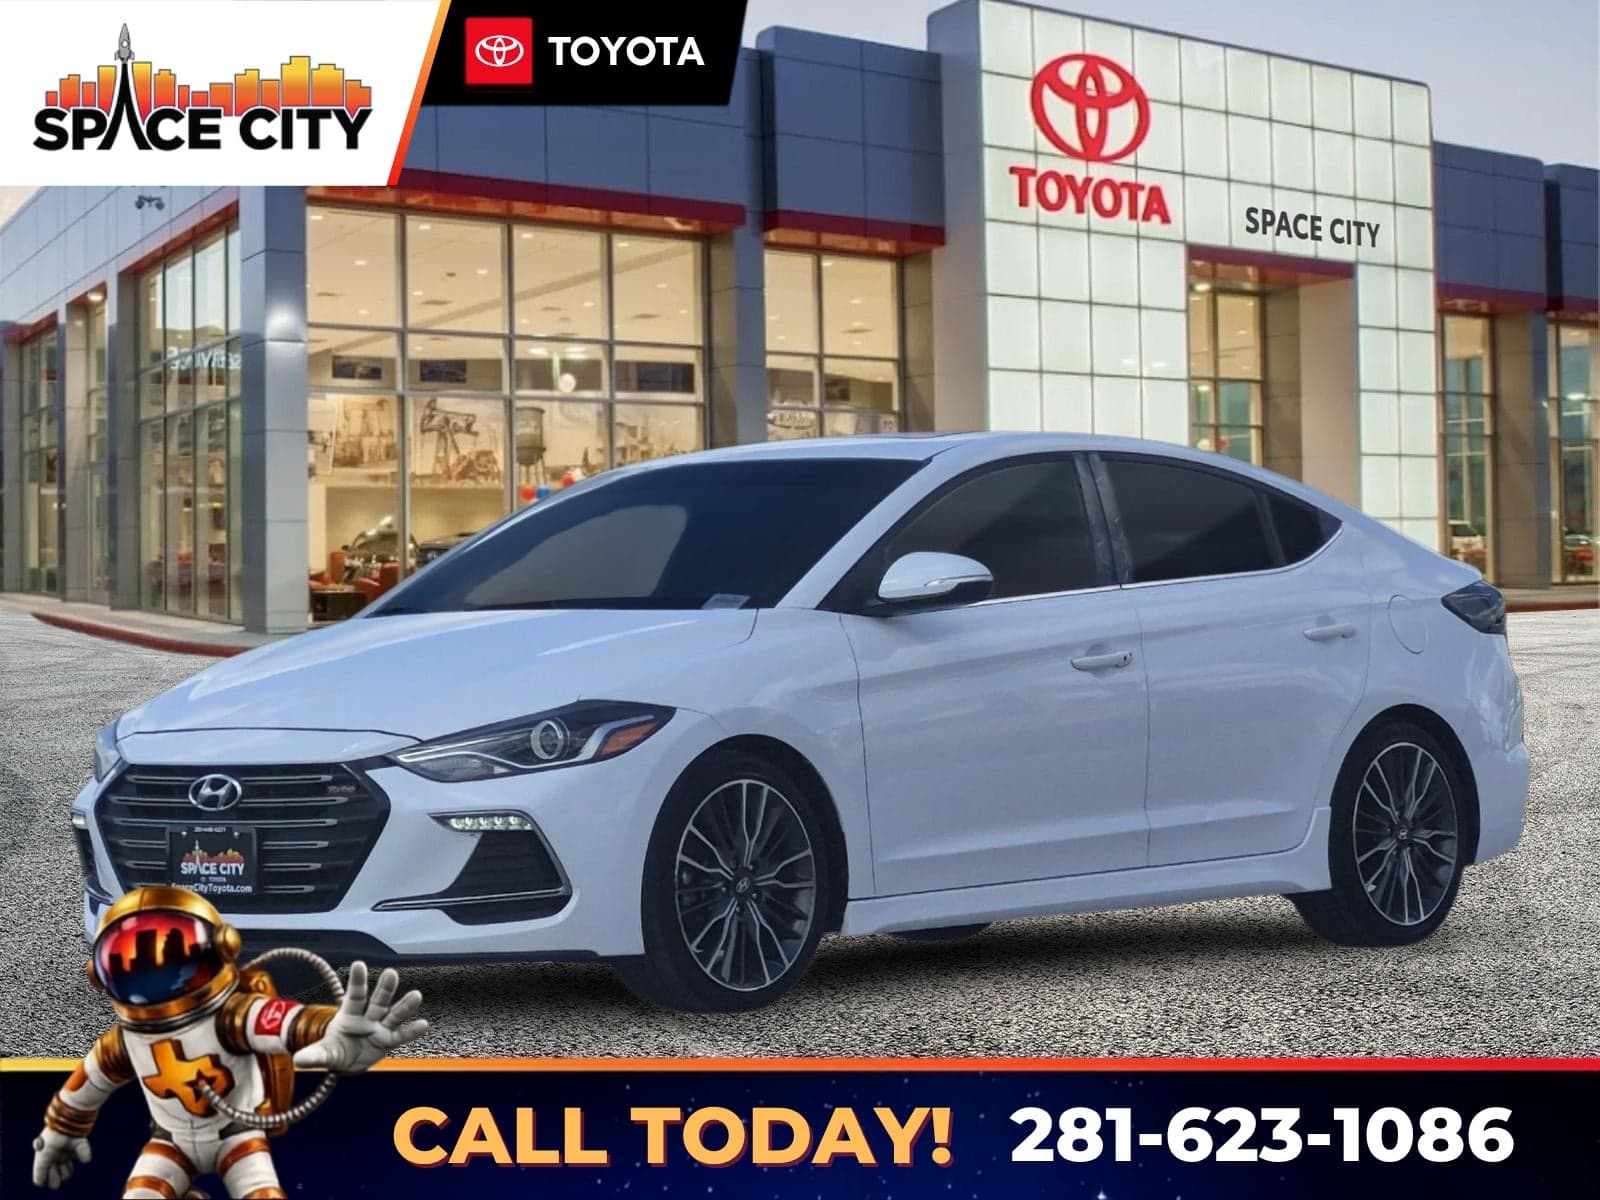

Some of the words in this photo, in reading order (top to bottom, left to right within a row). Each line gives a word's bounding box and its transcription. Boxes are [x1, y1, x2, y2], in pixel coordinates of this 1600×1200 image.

[1009, 166, 1171, 224] TOYOTA
[1245, 207, 1323, 241] SPACE
[1329, 217, 1380, 249] CITY
[180, 859, 217, 875] SPACE
[219, 862, 245, 875] CITY
